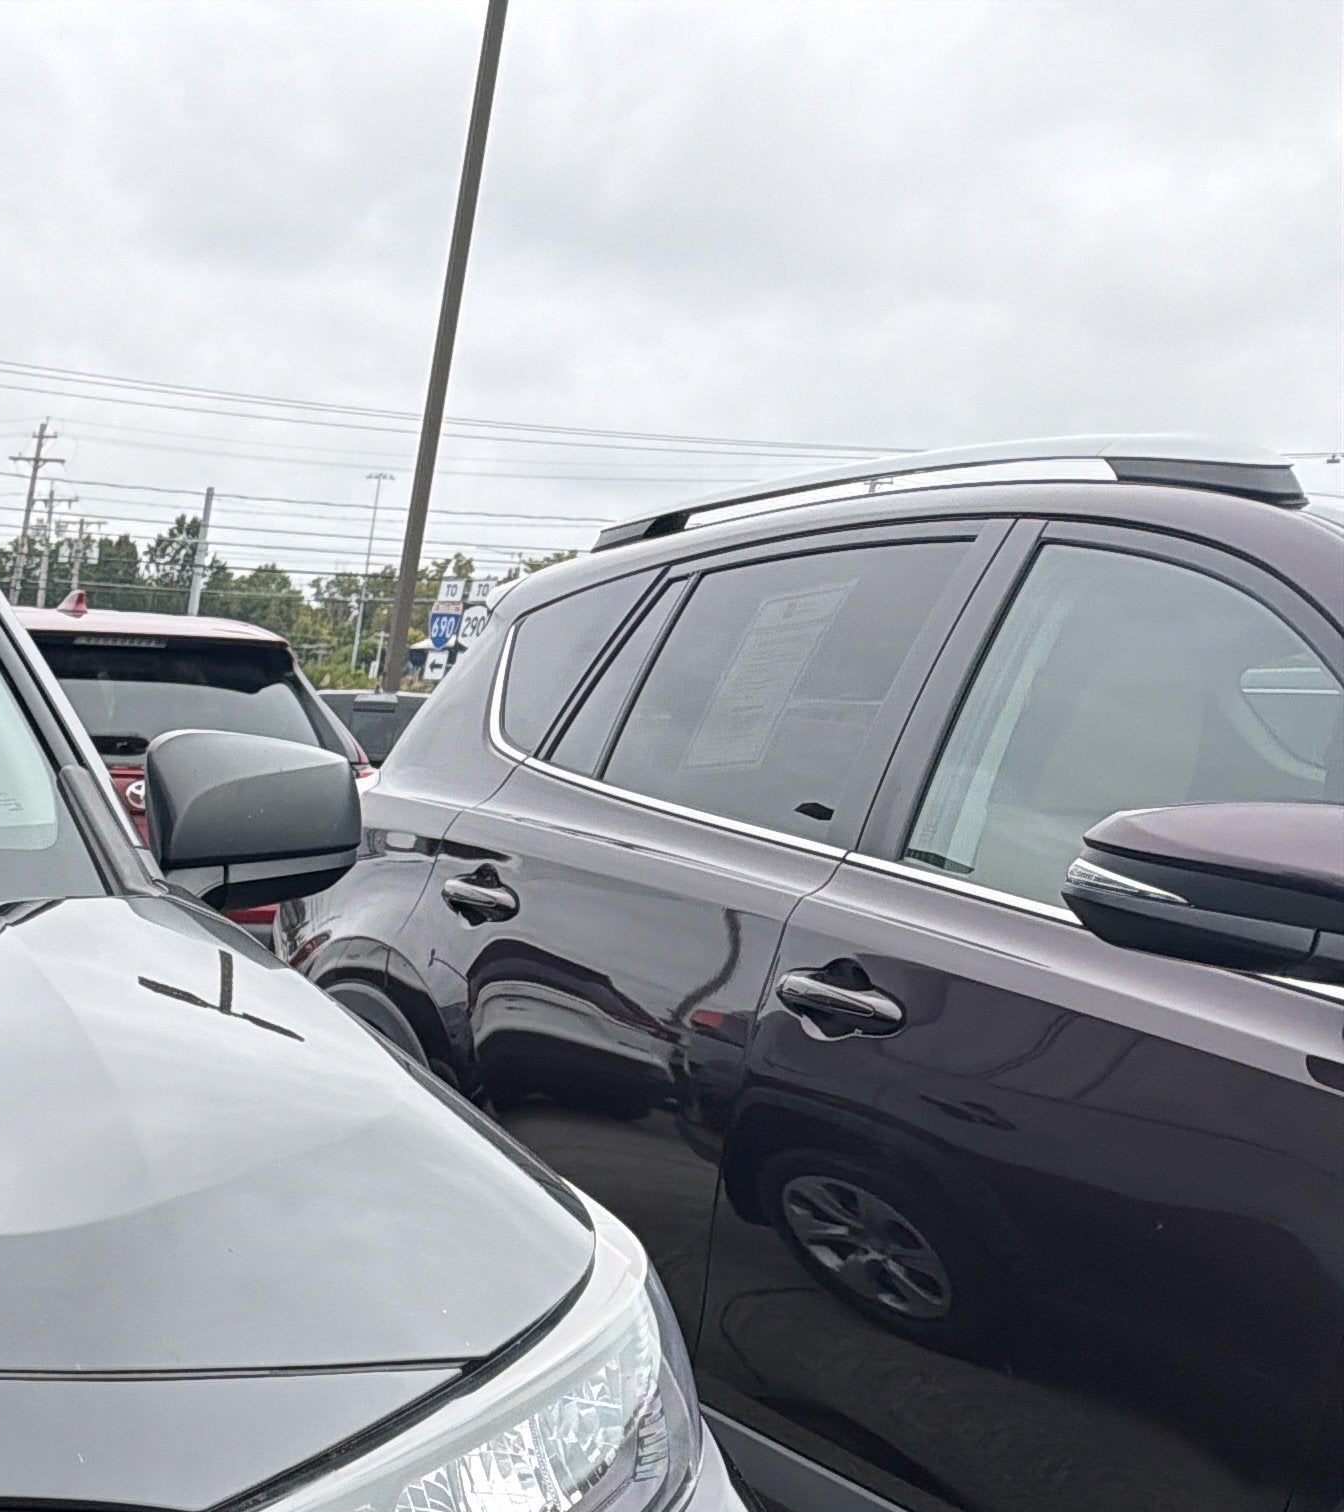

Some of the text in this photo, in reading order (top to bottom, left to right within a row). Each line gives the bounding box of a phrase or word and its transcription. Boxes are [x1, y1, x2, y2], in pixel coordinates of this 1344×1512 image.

[445, 583, 459, 598] TO
[476, 583, 490, 597] TO
[431, 616, 456, 638] 690
[461, 615, 486, 638] 290
